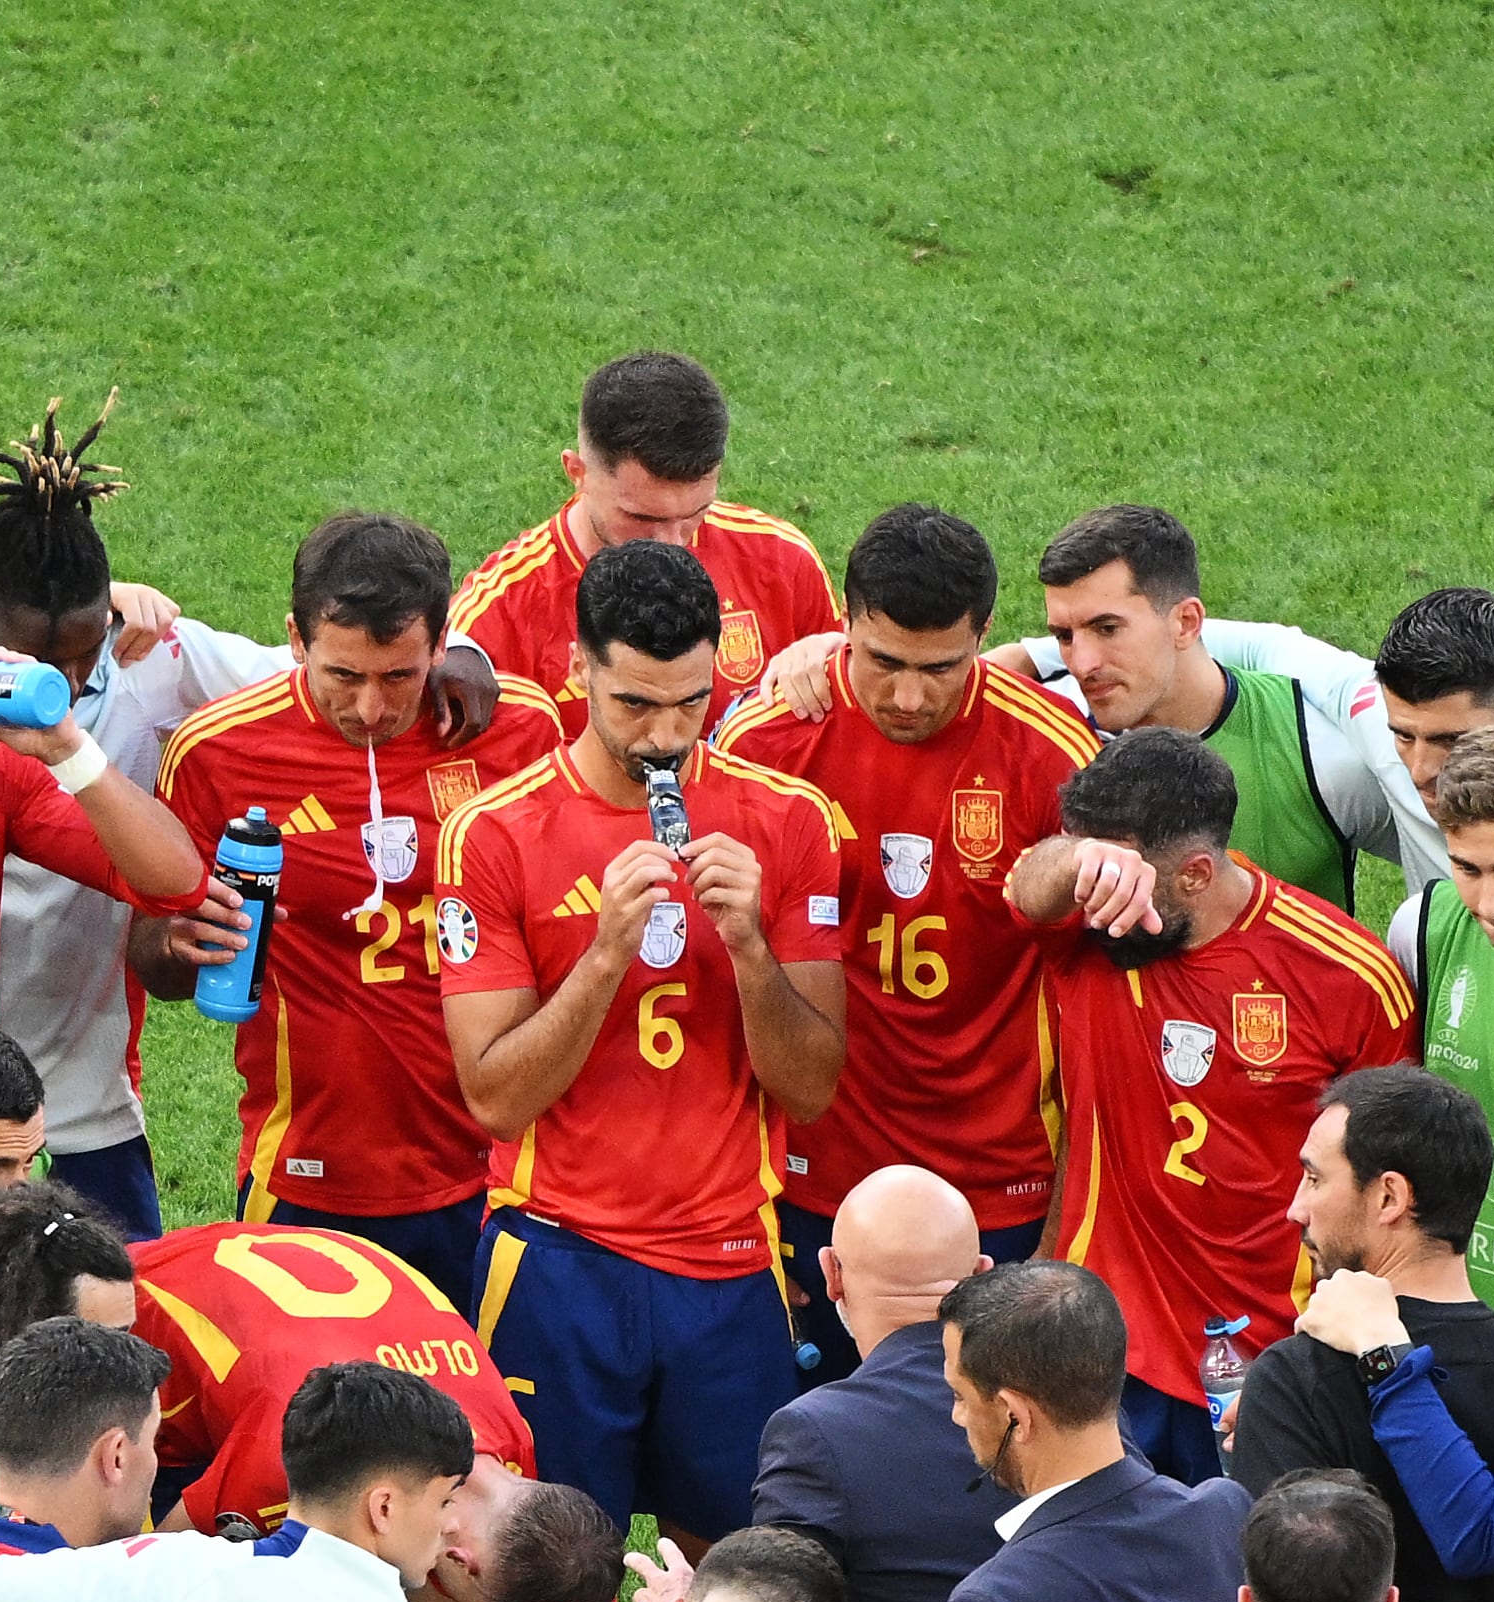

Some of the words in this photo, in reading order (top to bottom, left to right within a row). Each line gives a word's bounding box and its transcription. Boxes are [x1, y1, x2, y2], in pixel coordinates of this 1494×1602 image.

[355, 895, 441, 984] 21
[867, 913, 950, 1000] 16
[638, 982, 688, 1070] 6
[1163, 1102, 1208, 1187] 2
[375, 1339, 480, 1377] OLMO
